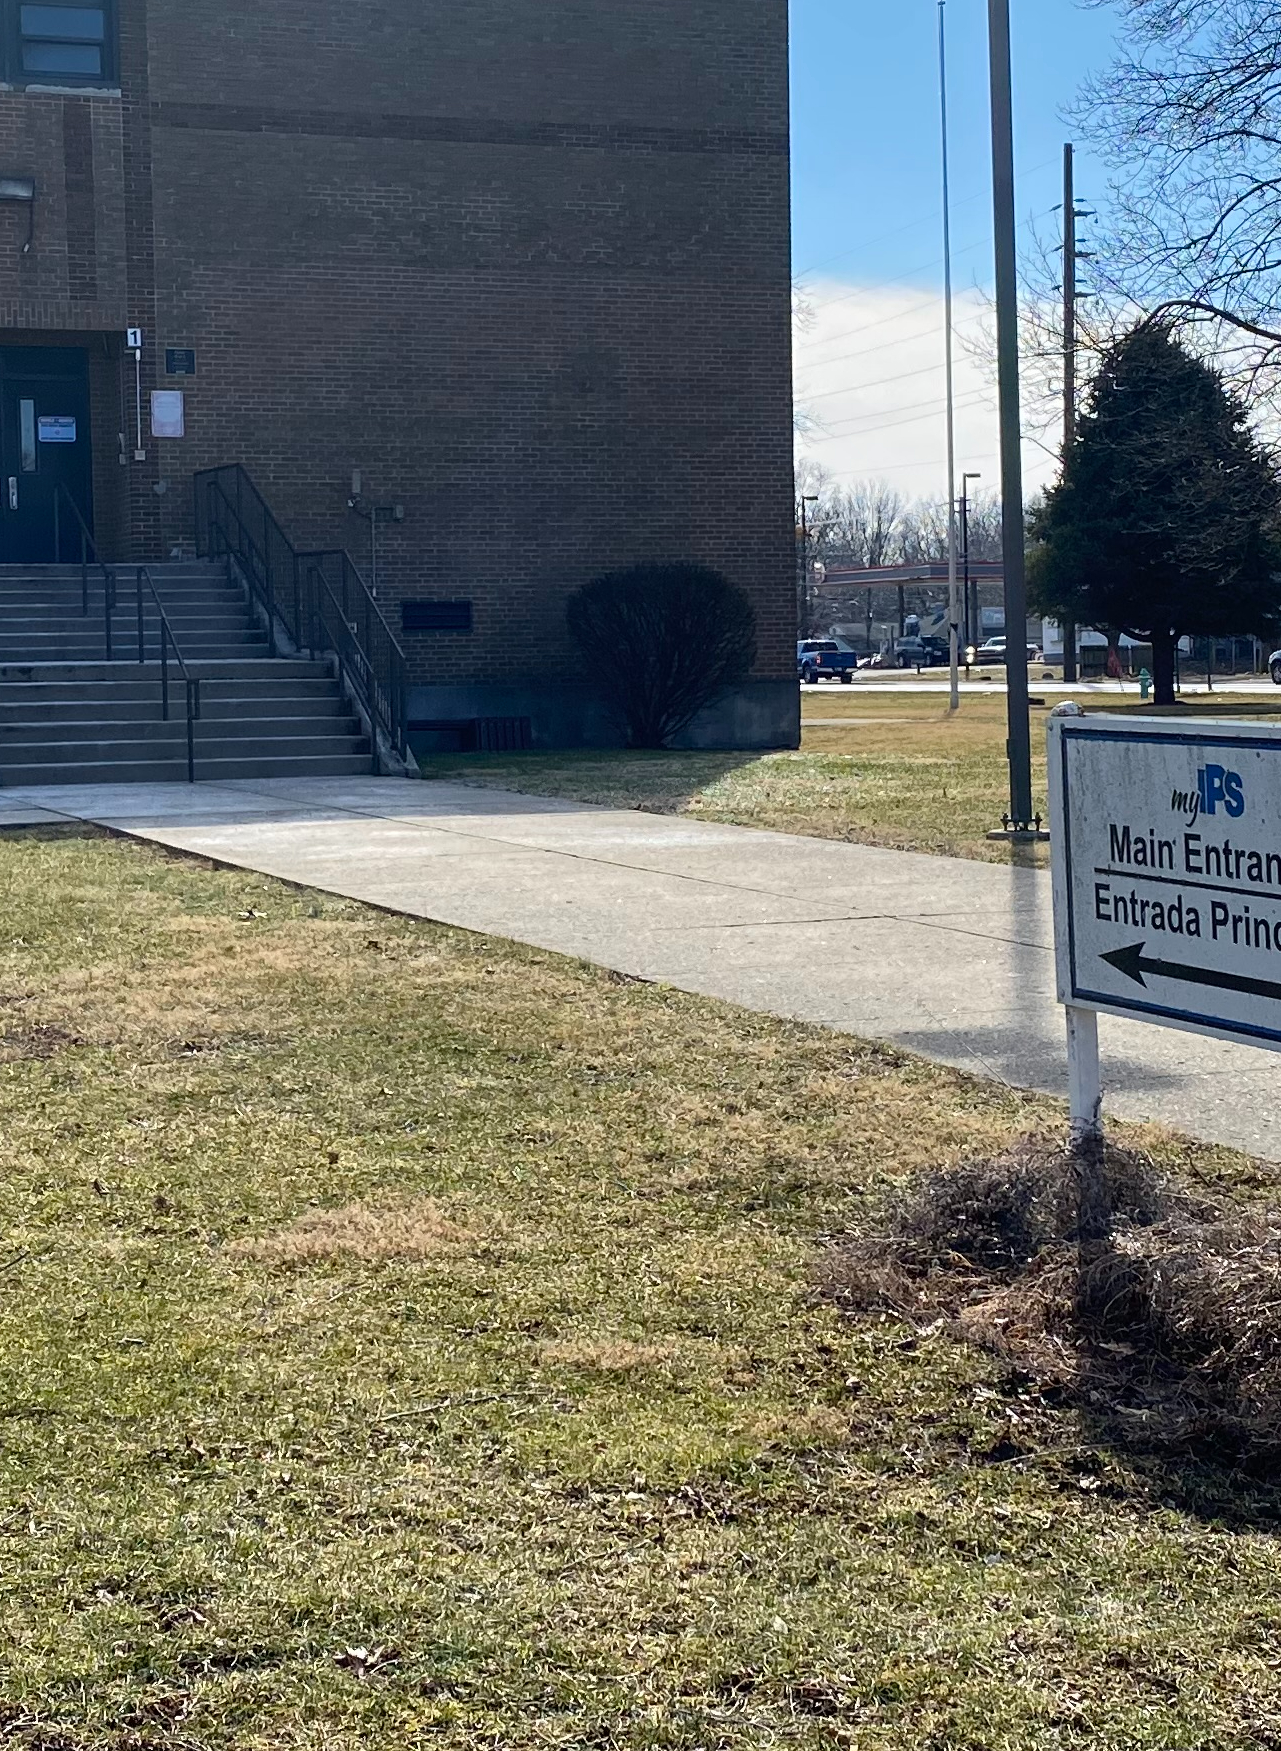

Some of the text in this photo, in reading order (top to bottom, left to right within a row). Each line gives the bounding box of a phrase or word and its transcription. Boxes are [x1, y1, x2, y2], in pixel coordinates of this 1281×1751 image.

[129, 330, 138, 345] 1
[1109, 823, 1174, 870] Main
[1094, 882, 1201, 938] Entrada
